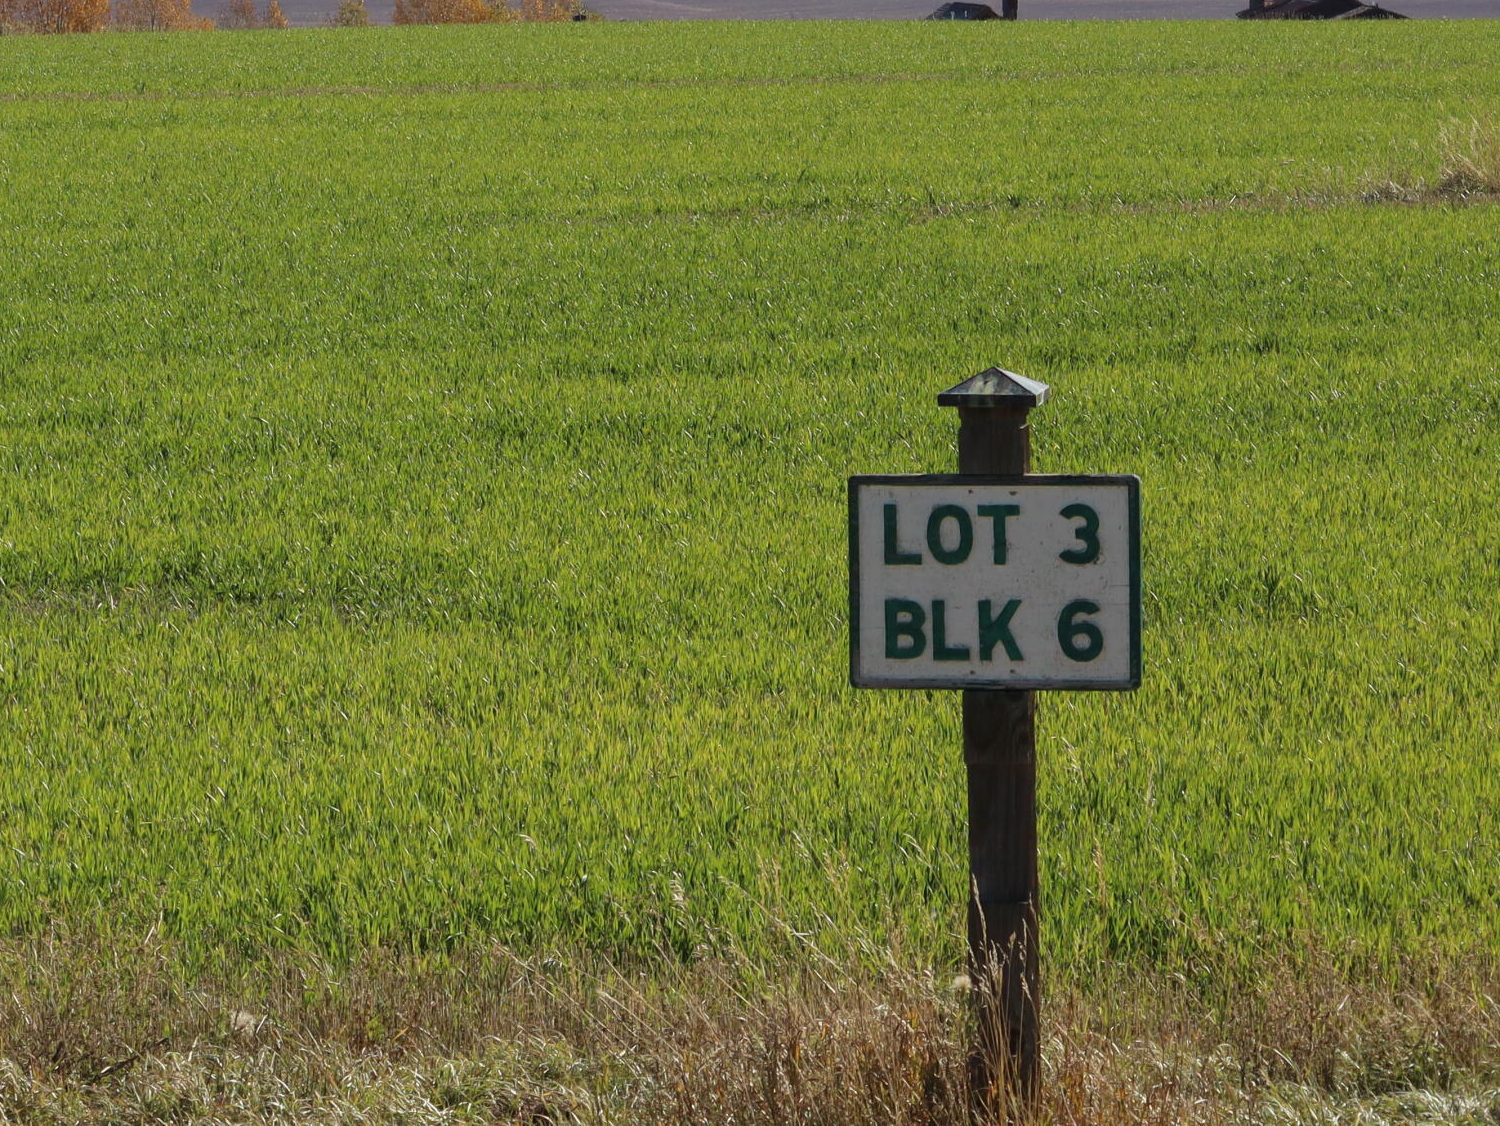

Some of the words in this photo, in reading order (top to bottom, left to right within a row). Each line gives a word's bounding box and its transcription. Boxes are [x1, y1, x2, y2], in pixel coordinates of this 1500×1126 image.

[883, 503, 1021, 566] LOT
[1058, 502, 1102, 565] 3
[884, 597, 1025, 662] BLK
[1056, 599, 1105, 662] 6
